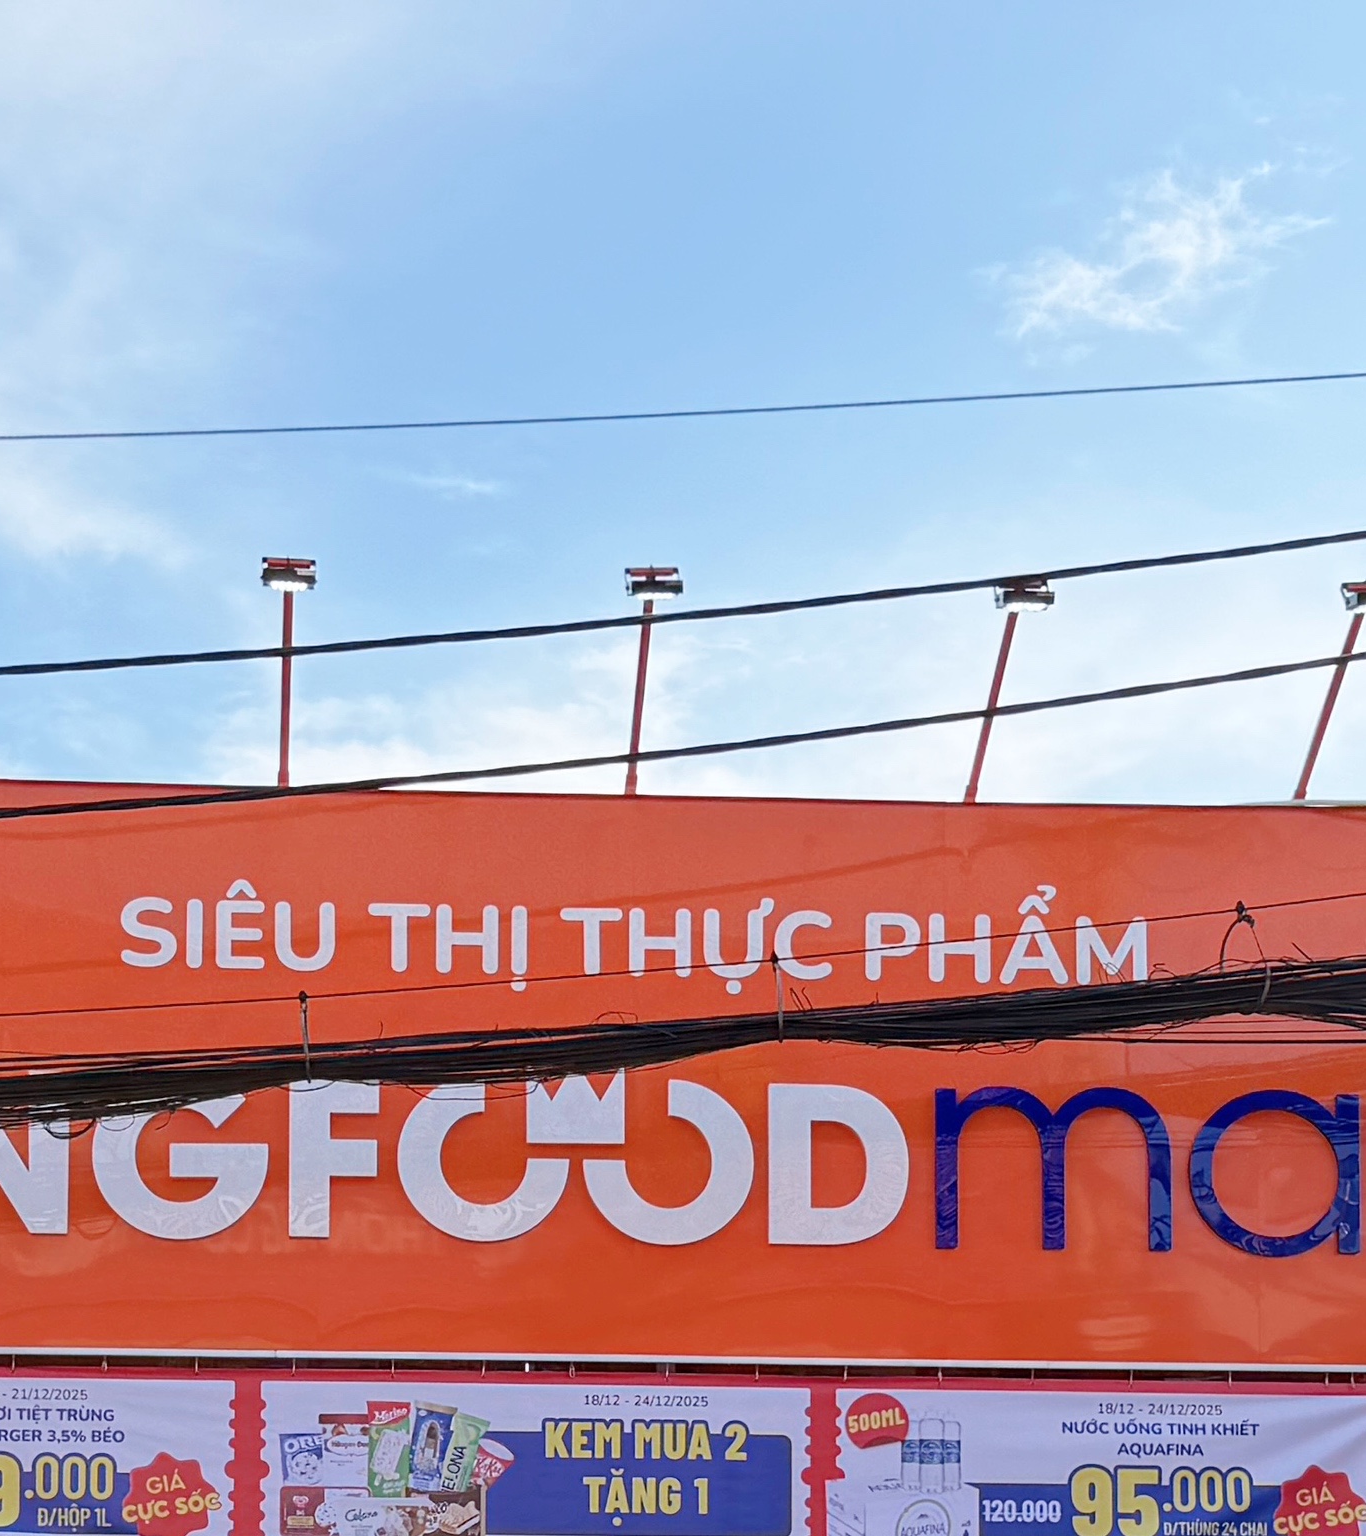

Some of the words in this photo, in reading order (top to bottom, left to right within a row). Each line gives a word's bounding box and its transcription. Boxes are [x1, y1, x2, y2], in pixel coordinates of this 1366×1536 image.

[120, 880, 335, 971] SIÊU
[368, 903, 528, 992] THỊ
[560, 897, 832, 995] THỰC
[865, 884, 1149, 986] PHẨM
[12, 1388, 88, 1401] 21/12/2025
[584, 1395, 620, 1406] 18/12
[635, 1395, 708, 1408] 24/12/2025
[16, 1406, 50, 1424] TIỆT
[54, 1405, 114, 1422] TRÙNG
[848, 1407, 905, 1434] 500ML
[1098, 1403, 1133, 1415] 18/12
[1148, 1404, 1222, 1416] 24/12/2025
[47, 1429, 86, 1444] 3,5%
[91, 1426, 125, 1443] BÉO
[1062, 1419, 1109, 1434] NƯỚC
[1114, 1419, 1162, 1436] UỐNG
[1167, 1423, 1206, 1435] TINH
[1212, 1420, 1259, 1436] KHIẾT
[545, 1420, 621, 1459] KEM
[635, 1422, 711, 1460] MUA
[724, 1424, 747, 1461] 2
[1117, 1442, 1203, 1458] AQUAFINA
[146, 1468, 186, 1492] GIÁ
[583, 1467, 681, 1527] TẶNG
[694, 1478, 708, 1514] 1
[1296, 1483, 1335, 1506] GIÁ
[121, 1499, 170, 1525] CỰC
[176, 1489, 222, 1517] SỐC
[1273, 1510, 1319, 1536] CỰC
